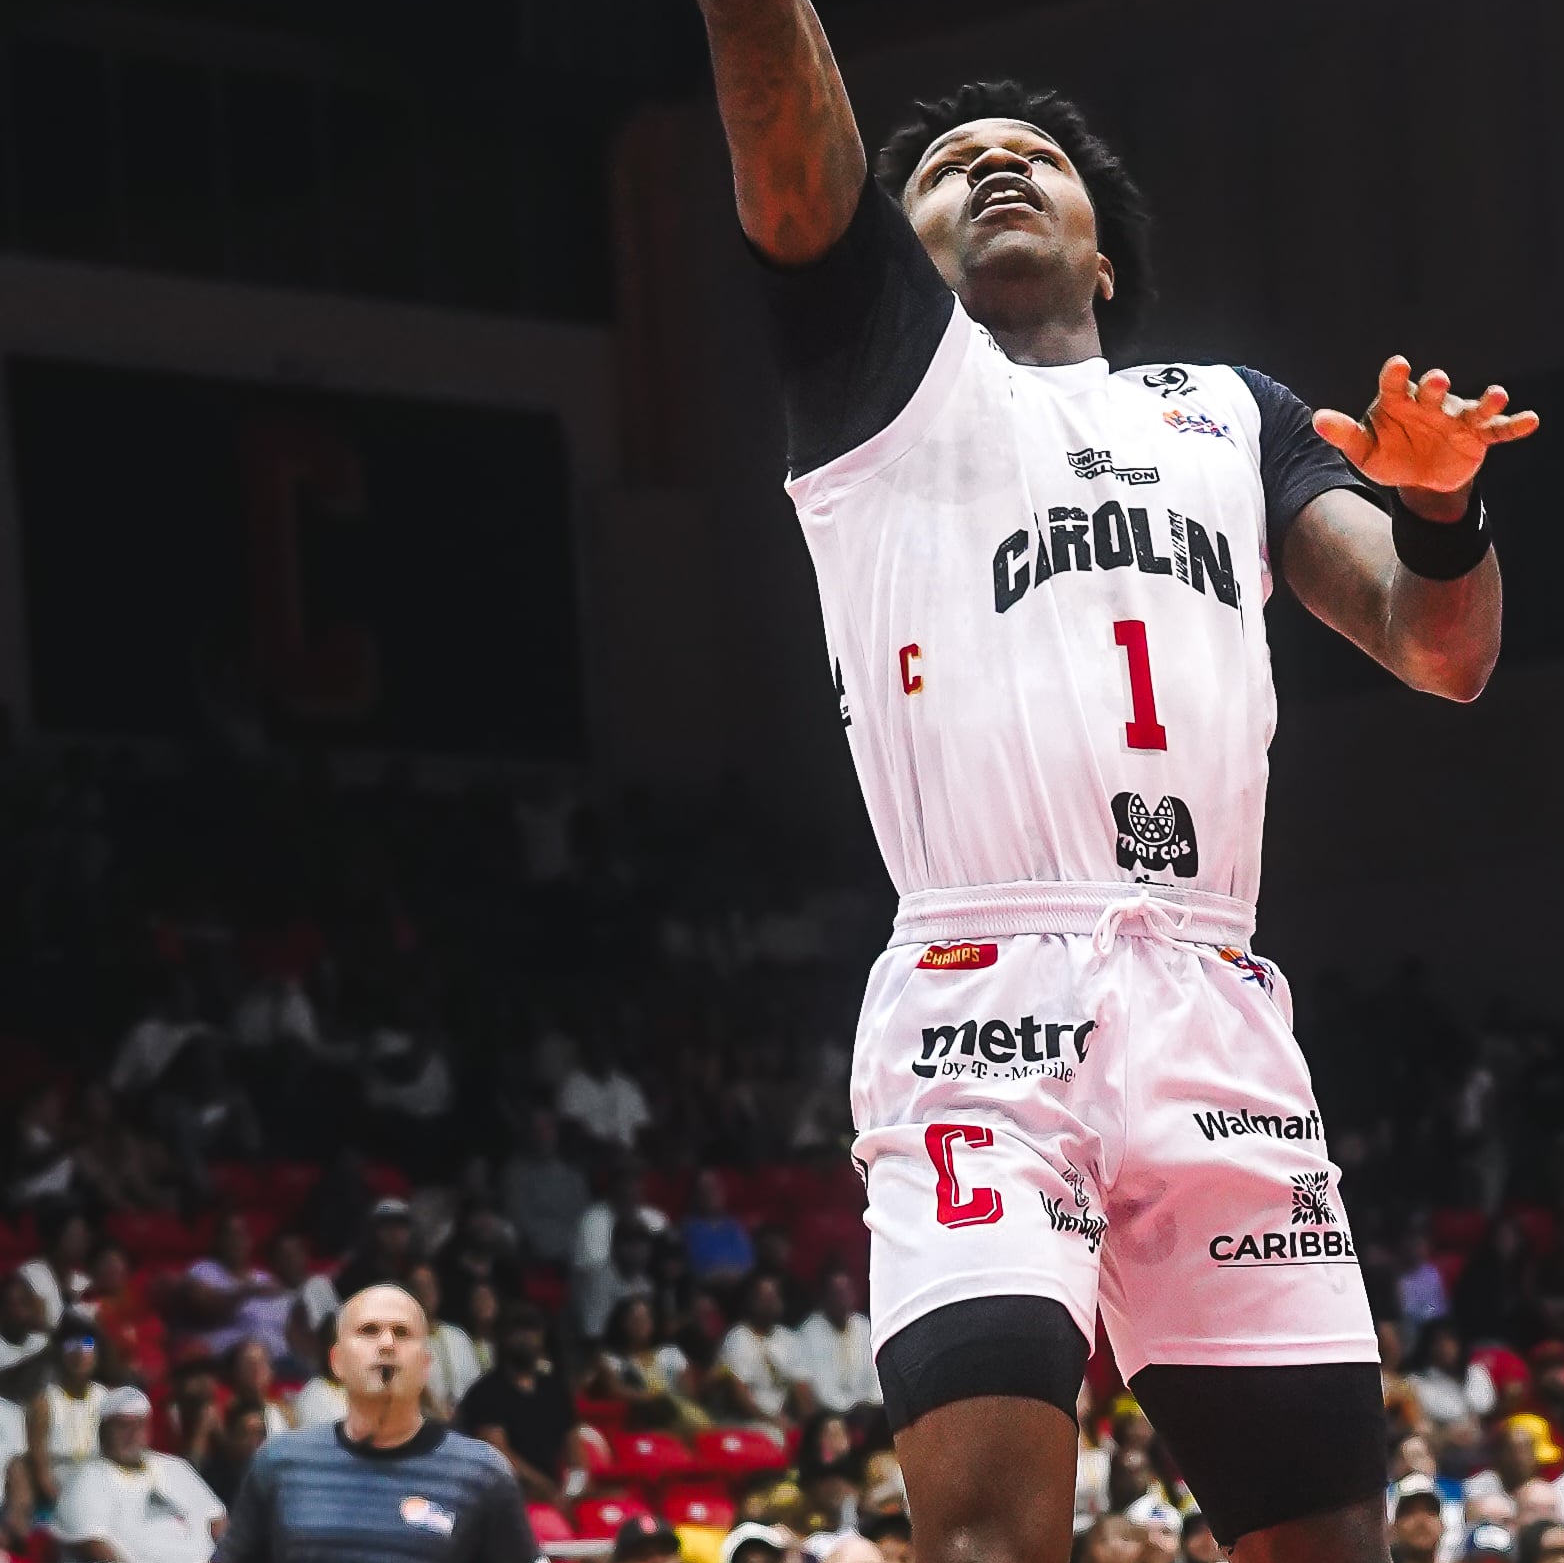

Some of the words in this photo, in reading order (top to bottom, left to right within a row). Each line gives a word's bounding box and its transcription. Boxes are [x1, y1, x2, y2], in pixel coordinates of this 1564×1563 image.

[899, 643, 924, 696] C
[1114, 619, 1167, 752] 1
[922, 947, 980, 966] CHAMPS
[942, 1059, 966, 1080] by
[924, 1123, 1004, 1230] C
